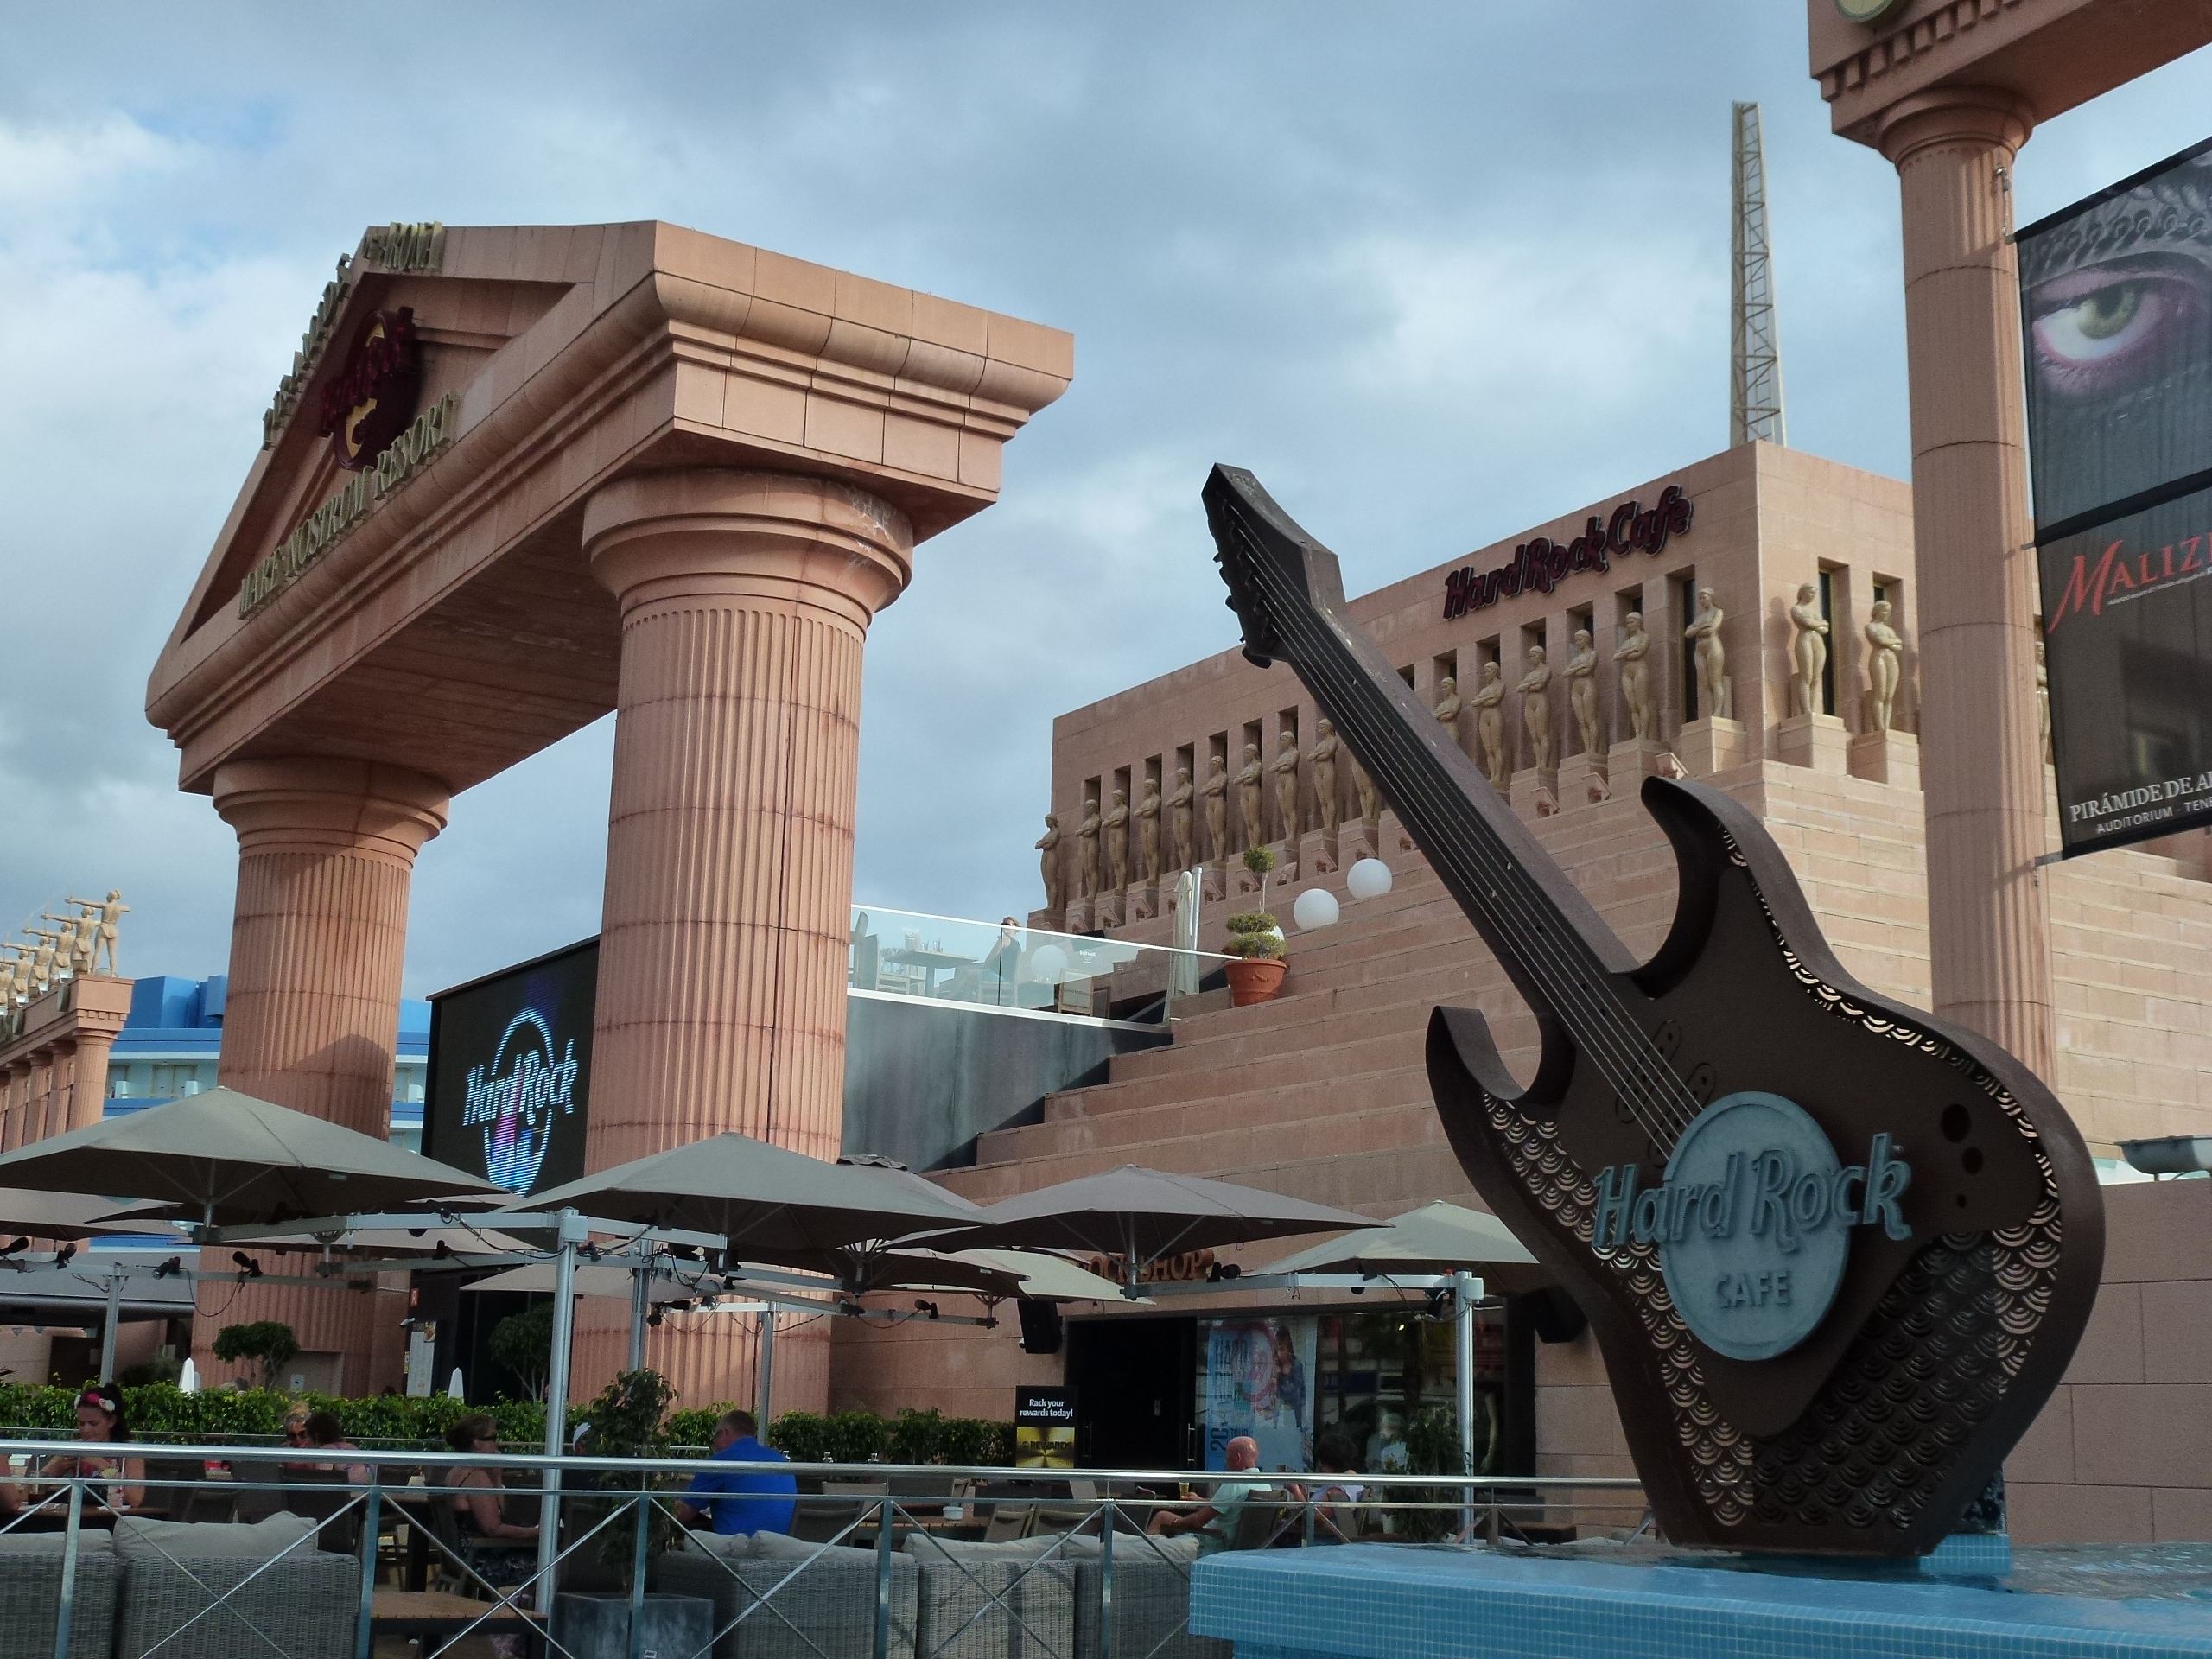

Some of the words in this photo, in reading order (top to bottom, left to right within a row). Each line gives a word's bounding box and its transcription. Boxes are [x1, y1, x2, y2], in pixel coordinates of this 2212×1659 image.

[374, 391, 459, 500] RESORT
[1442, 543, 1529, 620] Hard
[1524, 516, 1609, 594] Rock
[1607, 484, 1694, 556] Cafe
[2069, 784, 2164, 823] PIRÁMIDE
[2163, 777, 2194, 798] DE
[2095, 806, 2173, 835] AUDITORIUM
[462, 1053, 523, 1126] Hard
[518, 1039, 578, 1125] Rock
[1591, 1151, 1746, 1249] Hard
[1751, 1131, 1913, 1255] Rock
[1715, 1270, 1793, 1310] CAFE
[1020, 1408, 1049, 1417] rewards
[1049, 1408, 1073, 1420] today!
[1028, 1398, 1046, 1407] Rack
[1047, 1400, 1065, 1409] your
